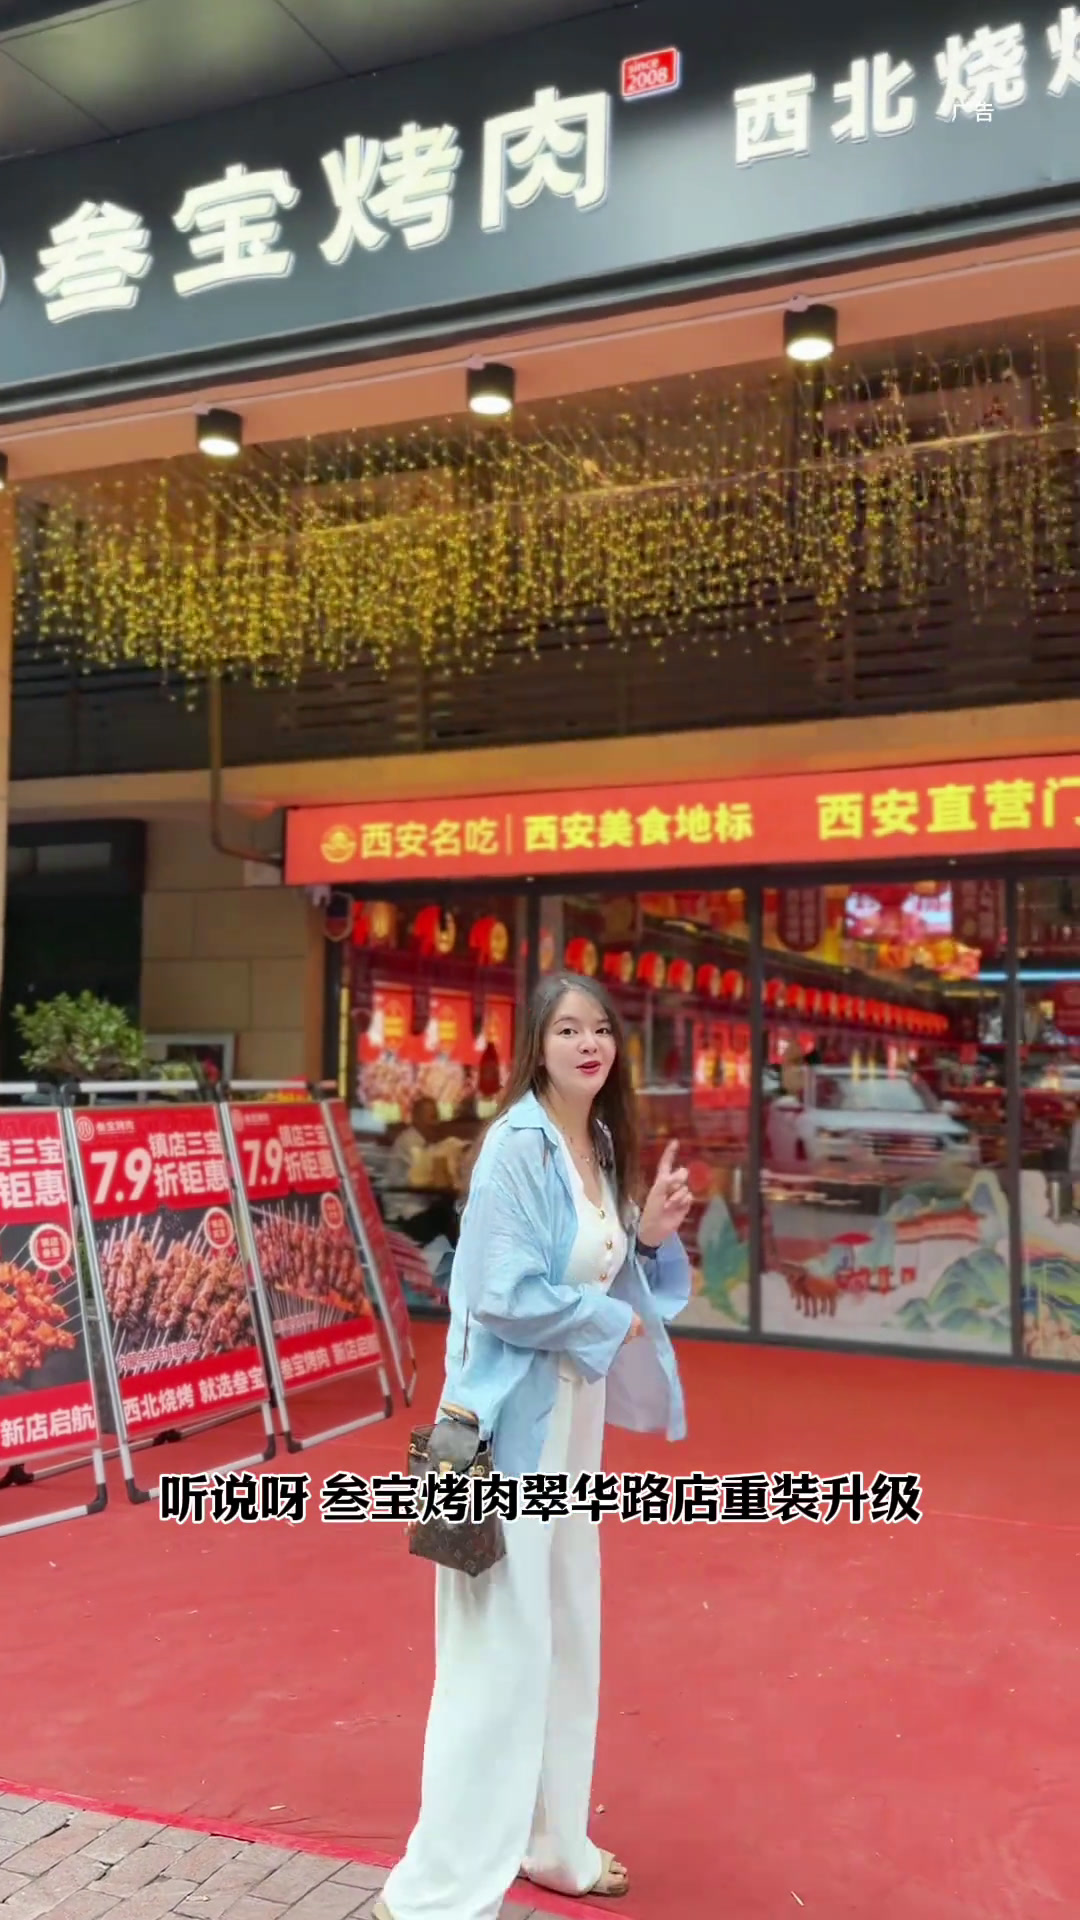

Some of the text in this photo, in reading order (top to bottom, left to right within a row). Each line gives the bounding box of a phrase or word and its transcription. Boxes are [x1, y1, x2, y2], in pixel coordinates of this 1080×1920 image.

[626, 66, 669, 92] 2008
[628, 57, 660, 73] since
[34, 86, 613, 324] 叁宝烤肉
[360, 817, 499, 860] 西安名吃
[523, 802, 754, 852] 西安美食地标
[90, 1147, 152, 1204] 7.9
[243, 1137, 284, 1187] 7.9
[122, 1366, 266, 1424] 西北烧烤 就选叁宝
[1, 1403, 96, 1448] 新店启航
